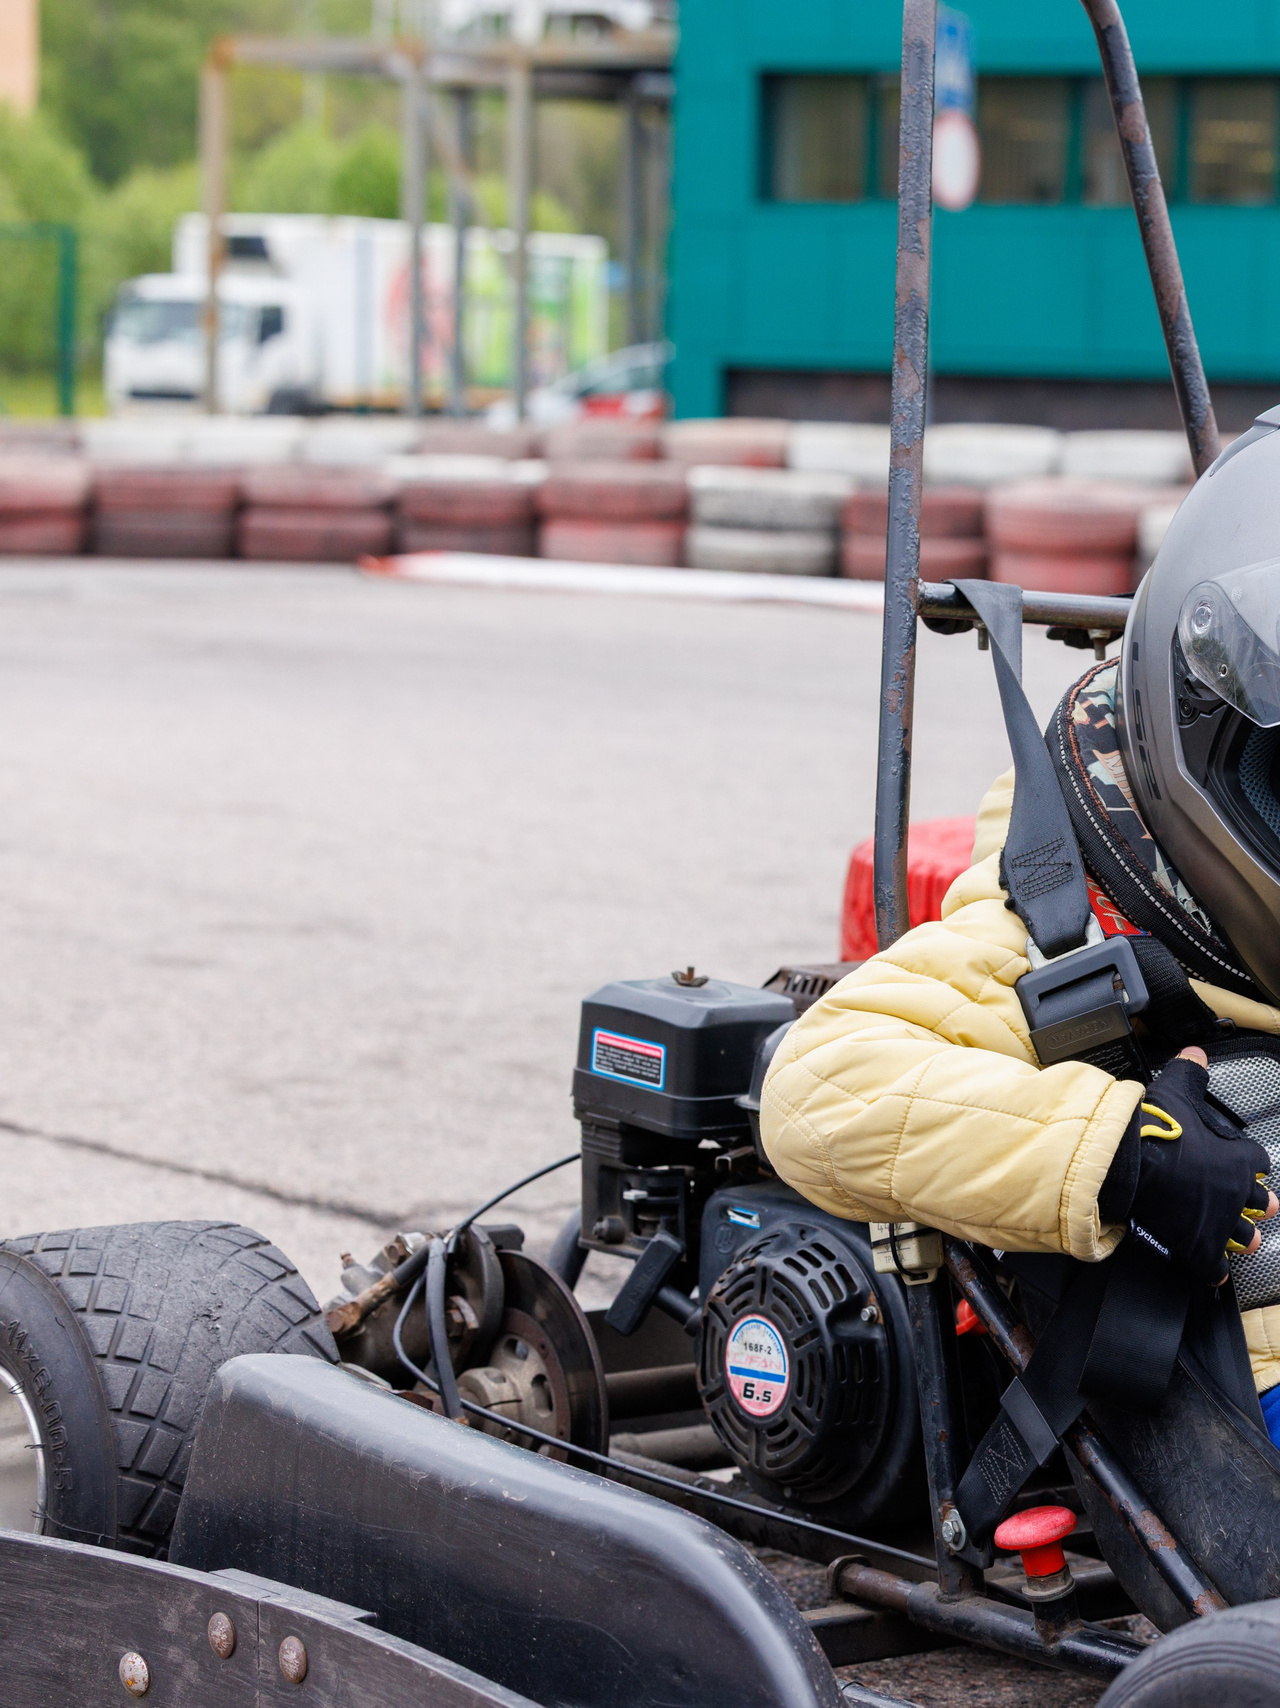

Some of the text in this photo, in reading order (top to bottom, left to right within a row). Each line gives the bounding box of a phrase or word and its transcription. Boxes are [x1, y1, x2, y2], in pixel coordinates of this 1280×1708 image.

[1132, 641, 1162, 800] LS2
[1136, 1226, 1169, 1255] cyclotech
[743, 1342, 772, 1355] 168F-2
[742, 1382, 772, 1403] 6.5
